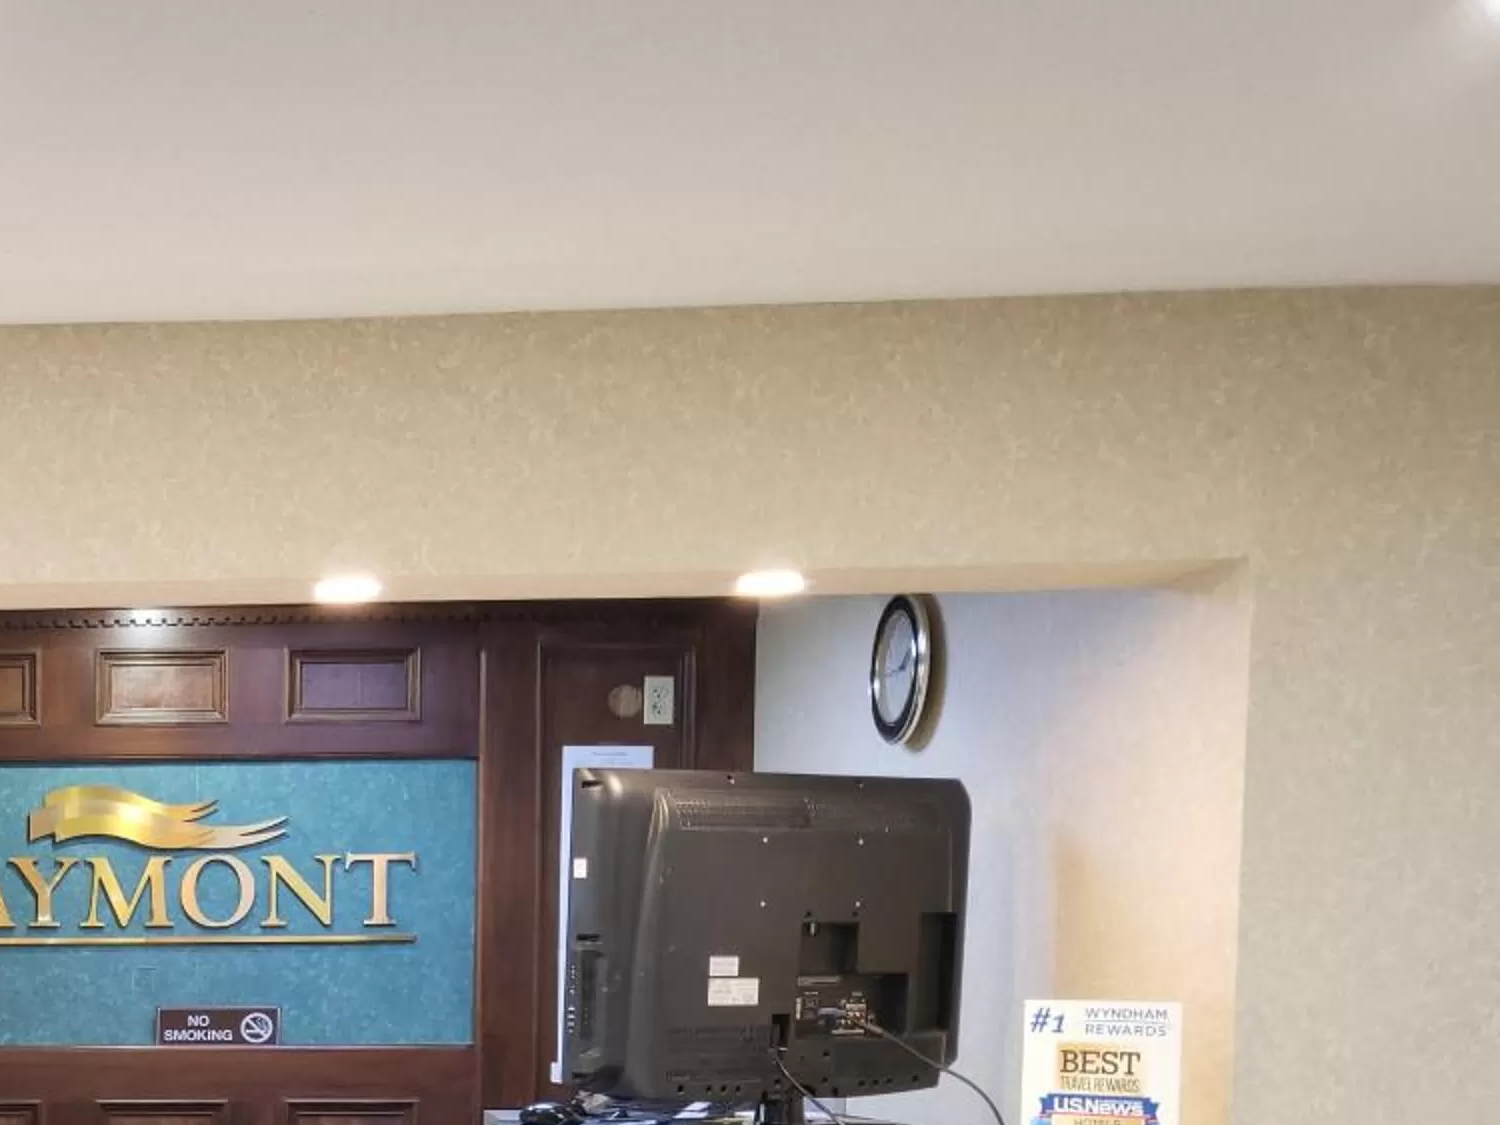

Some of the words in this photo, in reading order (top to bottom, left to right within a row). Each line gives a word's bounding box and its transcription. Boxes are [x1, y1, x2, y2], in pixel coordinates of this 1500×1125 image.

[1085, 1007, 1168, 1020] WYNDHAM
[187, 1015, 210, 1027] NO
[1031, 1008, 1065, 1034] #1
[163, 1029, 233, 1041] SMOKING
[1085, 1023, 1167, 1037] REWARDS
[1060, 1049, 1141, 1076] BEST
